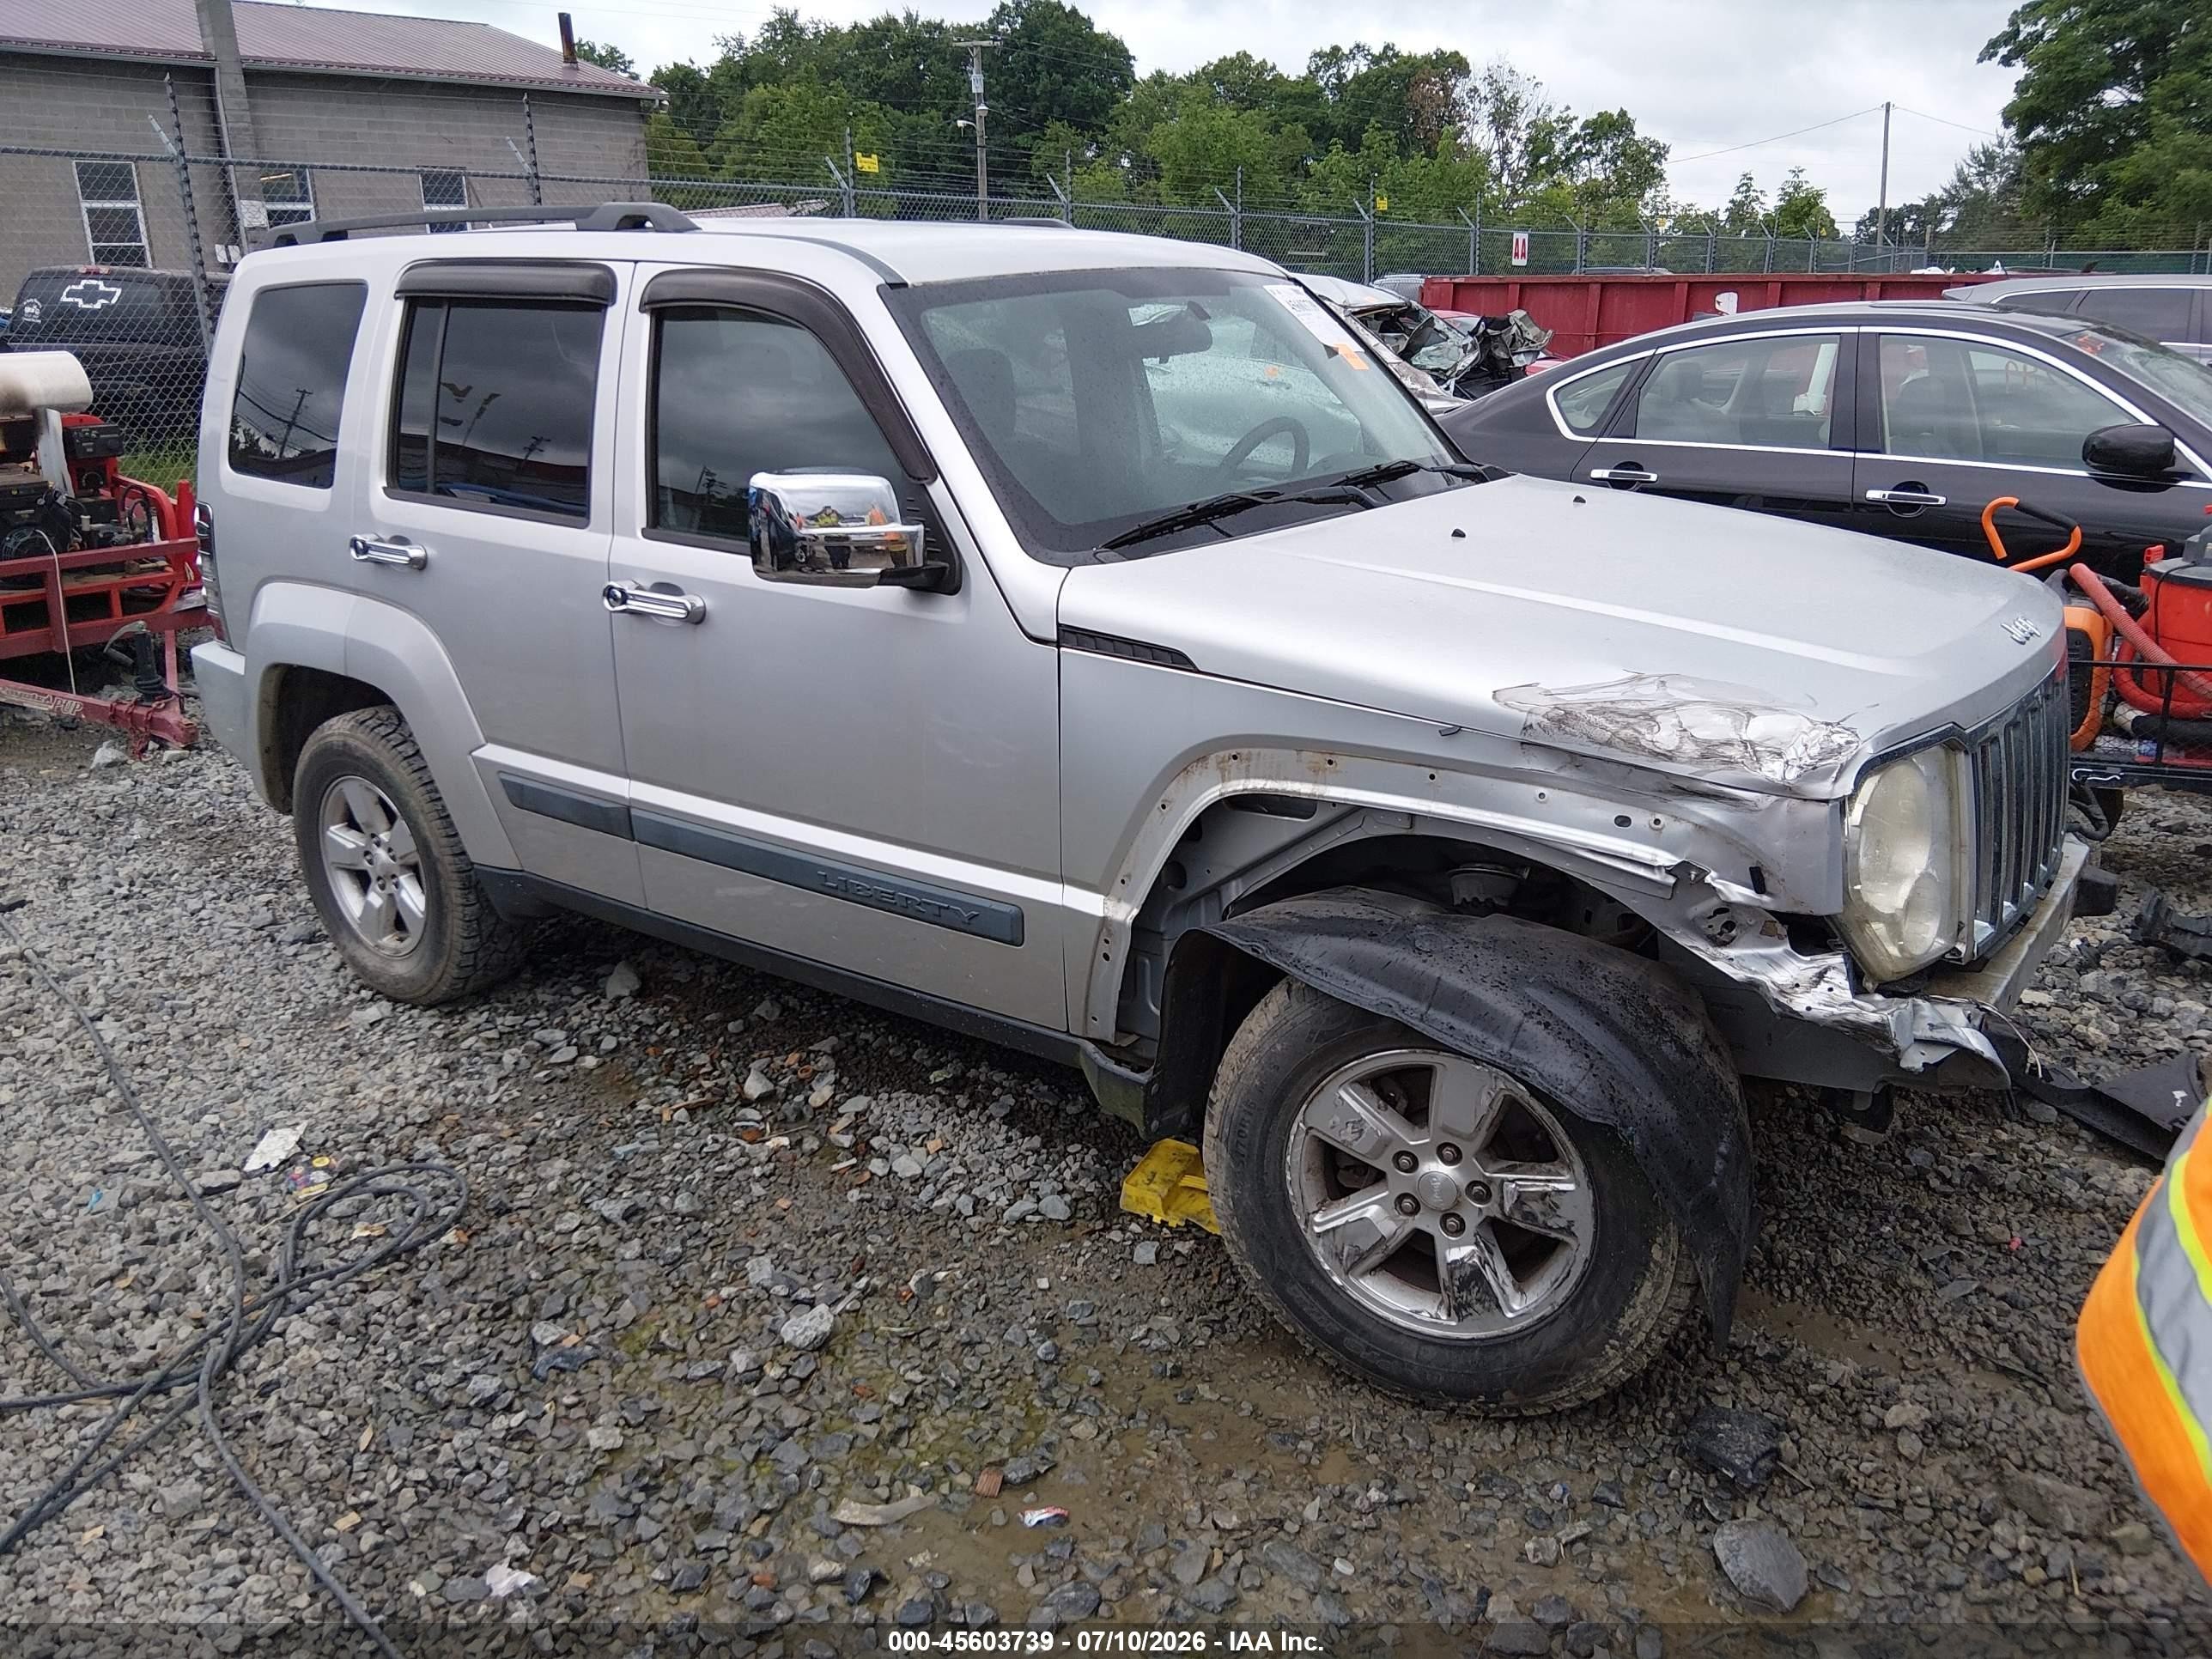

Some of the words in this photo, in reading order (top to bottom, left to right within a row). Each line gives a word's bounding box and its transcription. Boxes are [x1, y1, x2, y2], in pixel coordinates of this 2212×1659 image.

[1513, 238, 1526, 260] AA
[2000, 617, 2041, 645] Jeep
[817, 871, 981, 925] LIBERTY
